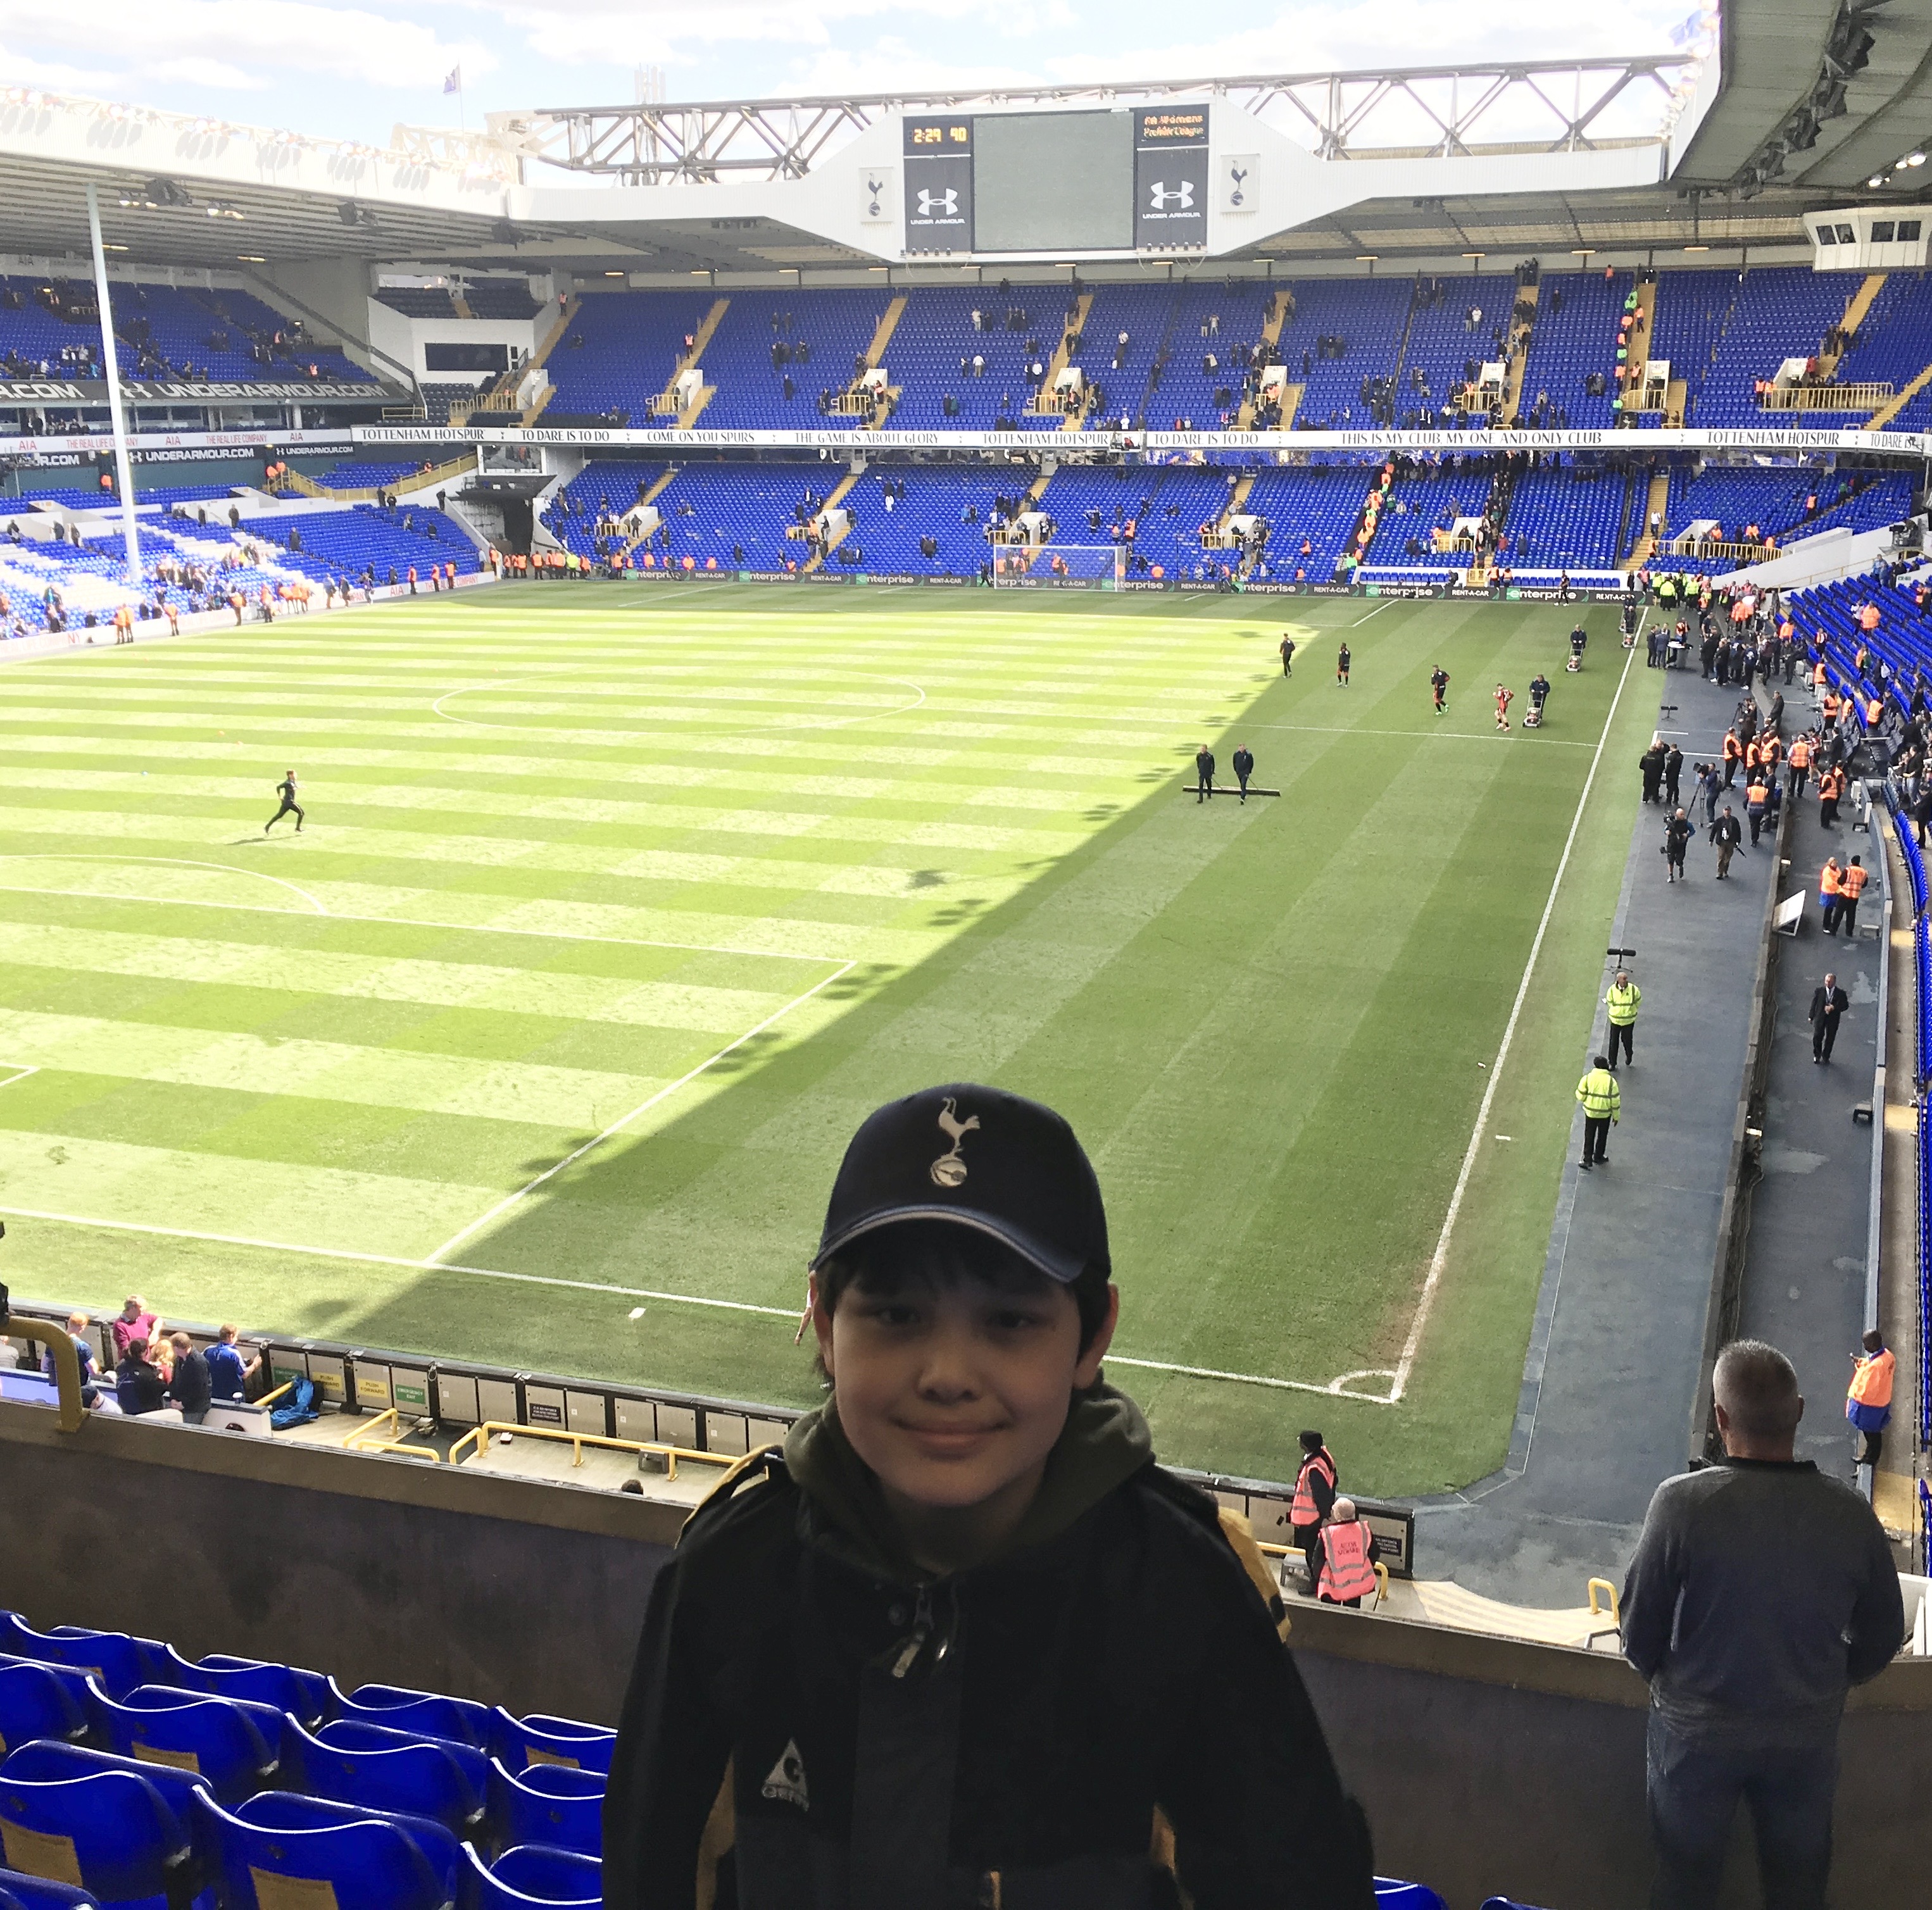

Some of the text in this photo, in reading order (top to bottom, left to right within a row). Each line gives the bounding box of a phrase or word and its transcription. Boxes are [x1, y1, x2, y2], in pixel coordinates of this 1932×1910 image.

[913, 127, 967, 143] 2:29 90
[155, 384, 389, 397] UNDERARMOUR.COM
[206, 434, 267, 444] THE REAL LIFE COMPANY
[290, 433, 303, 441] AIA
[361, 429, 484, 440] TOTTENHAM HOTSPUR
[520, 430, 610, 442] TO DARE IS TO DO
[647, 432, 755, 443] COME ON YOU SPURS
[794, 432, 940, 444] THE GAME IS ABOUT GLORY
[982, 434, 1108, 445] TOTTENHAM HOTSPUR
[1154, 434, 1258, 445] TO DARE IS TO DO
[1341, 432, 1368, 444] THIS
[1372, 432, 1383, 444] IS
[1386, 433, 1405, 444] MY
[1446, 432, 1466, 444] MY
[1469, 432, 1495, 444] ONE
[1500, 432, 1527, 444] AND
[1531, 432, 1564, 444] ONLY
[1568, 432, 1602, 444] CLUB
[1707, 432, 1840, 445] TOTTENHAM HOTSPUR
[18, 440, 37, 451] AIA
[66, 439, 78, 449] THE
[79, 439, 94, 448] REAL
[96, 438, 108, 447] LIFE
[165, 436, 181, 446] AIA
[1871, 434, 1880, 447] TO
[1882, 434, 1903, 448] DARE
[146, 448, 254, 461] UNDERARMOUR.COM
[285, 446, 353, 456] UNDERARMOUR.COM
[739, 572, 796, 582] enterprise
[856, 575, 914, 585] enterprise
[390, 585, 404, 597] AIA
